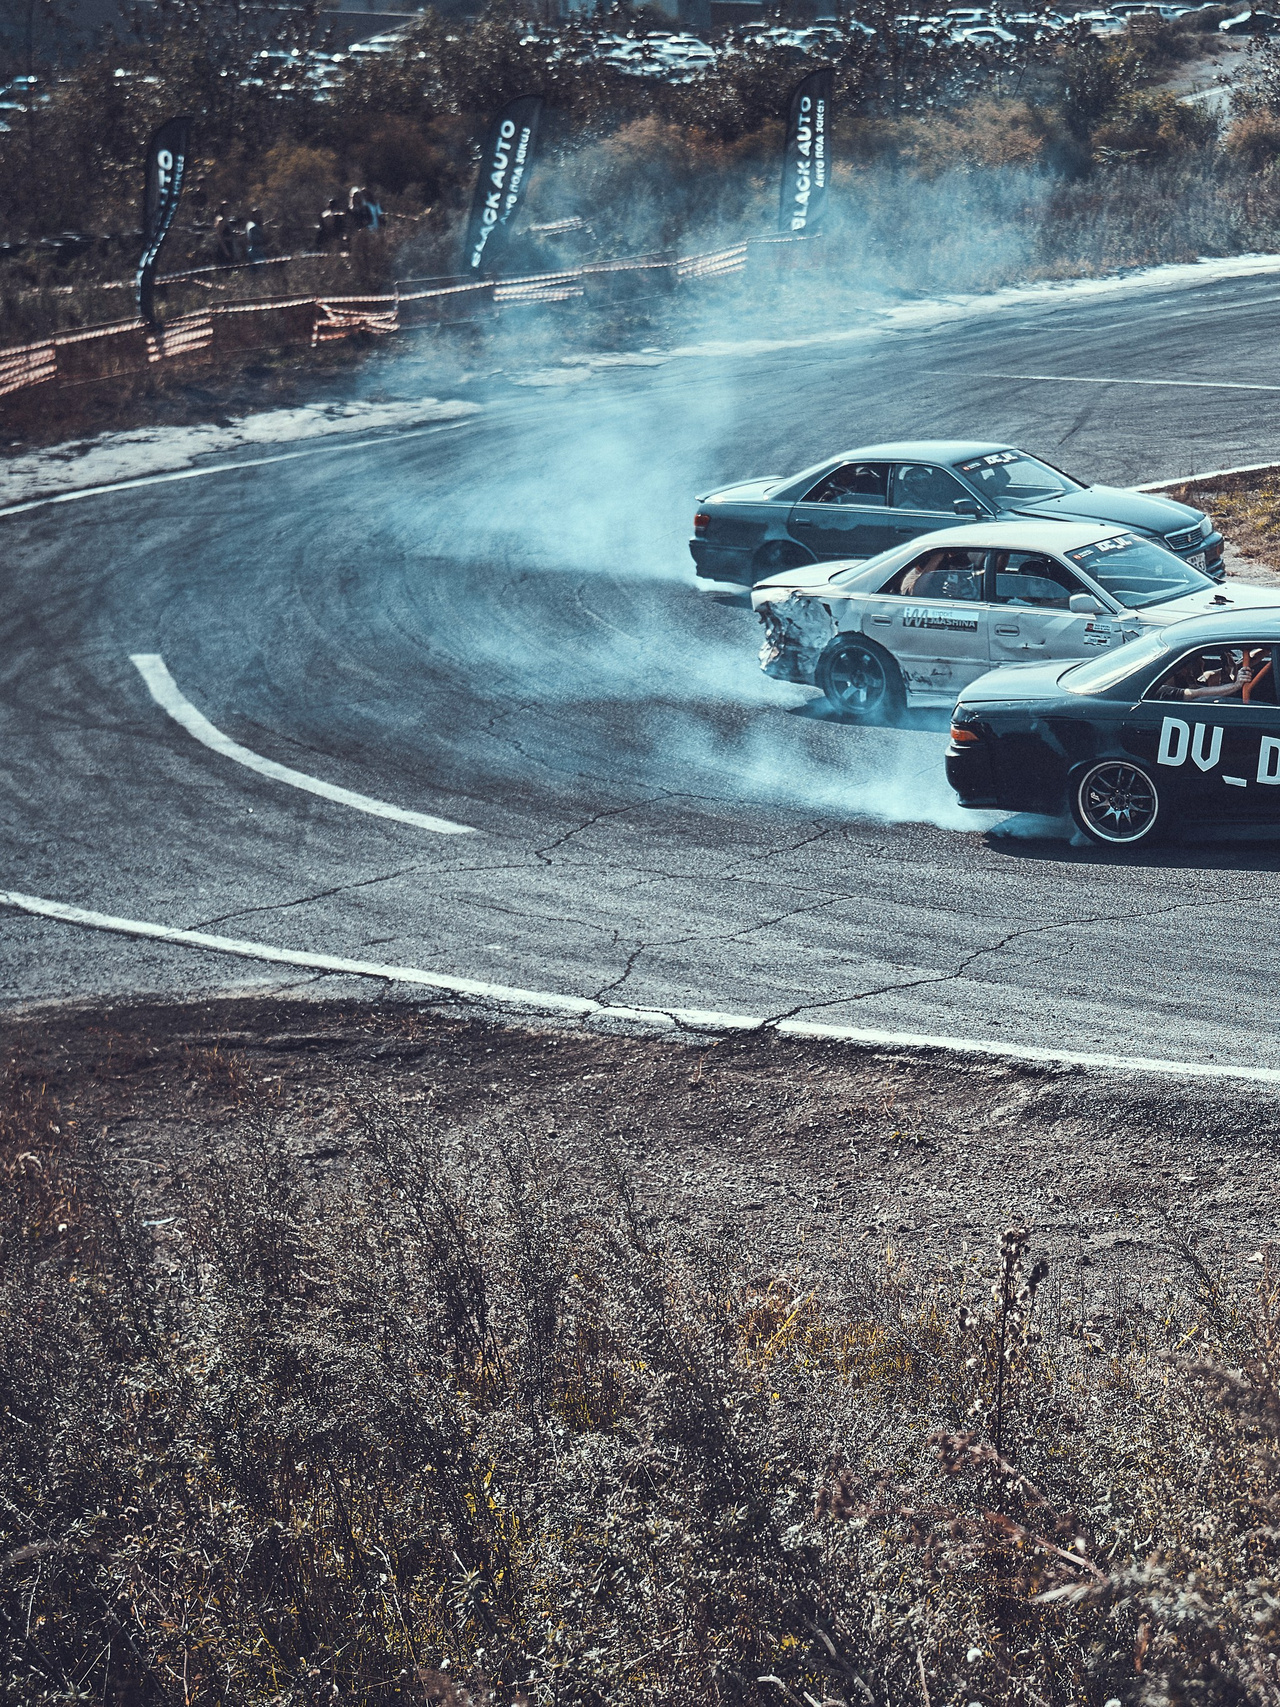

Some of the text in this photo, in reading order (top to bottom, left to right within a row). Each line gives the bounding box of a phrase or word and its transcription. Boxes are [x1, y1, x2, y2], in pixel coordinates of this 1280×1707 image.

[490, 120, 516, 189] AUTO
[791, 96, 812, 231] BLACK AUTO
